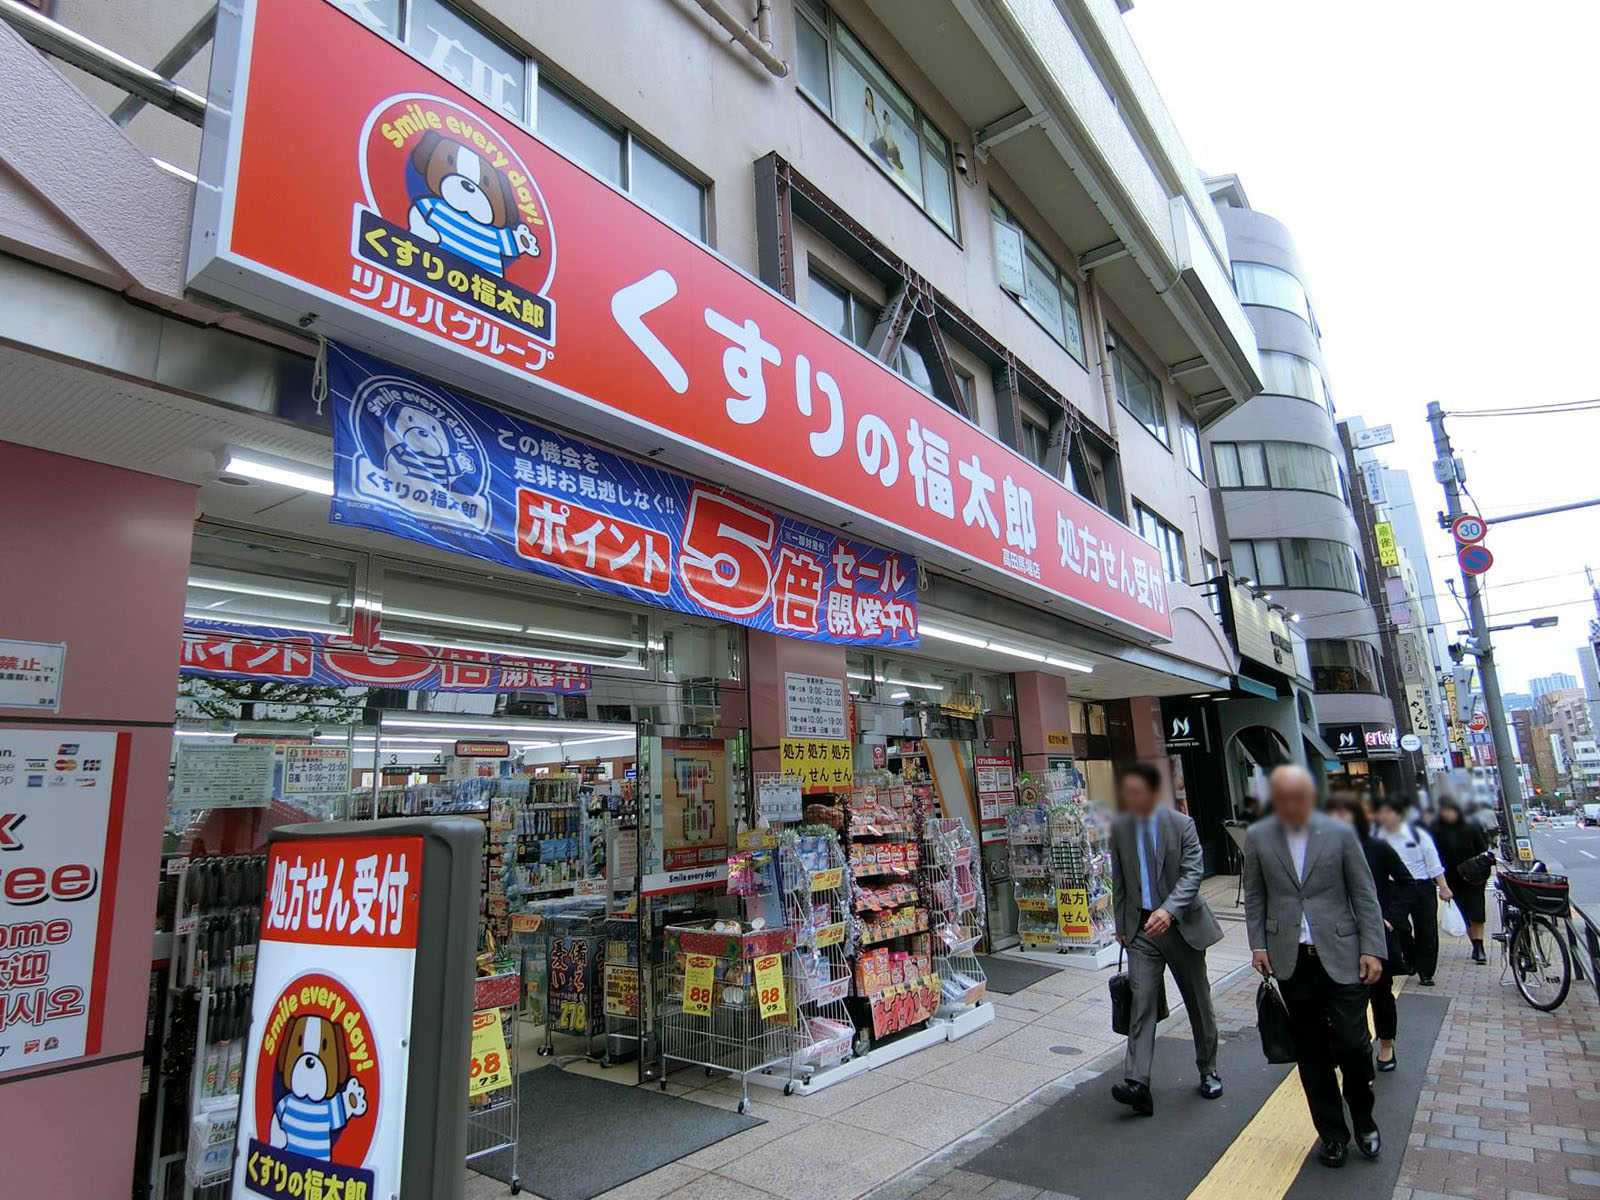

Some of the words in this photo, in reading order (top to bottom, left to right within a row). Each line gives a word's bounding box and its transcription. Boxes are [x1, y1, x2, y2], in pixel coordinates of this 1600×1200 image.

[380, 103, 442, 151] Smile
[445, 112, 510, 170] every
[508, 156, 545, 229] day!
[362, 226, 547, 330] くすりの福太郎
[349, 263, 555, 372] ツルハグループ
[402, 391, 446, 421] every
[444, 417, 475, 451] day!
[610, 267, 1037, 555] くすりの福太郎
[1056, 509, 1166, 616] 処方せん受付
[497, 427, 600, 475] この機会を
[365, 470, 479, 520] くすりの福太郎
[526, 501, 668, 584] ポイント
[679, 487, 777, 615] 5
[1460, 522, 1480, 538] 30
[771, 547, 823, 634] 倍
[832, 544, 906, 593] セール
[390, 754, 398, 765] 3
[433, 754, 441, 765] 4
[783, 742, 804, 760] 処方
[808, 742, 829, 760] 処方
[832, 744, 850, 760] 処方
[809, 768, 829, 782] せん
[832, 768, 853, 783] せん
[266, 853, 409, 937] 処方せん受付
[1060, 892, 1084, 906] 処方
[1062, 911, 1087, 923] せん
[559, 1001, 587, 1031] 278
[689, 986, 711, 1004] 88
[760, 987, 780, 1005] 88
[300, 985, 347, 1020] every
[342, 1010, 375, 1073] day!
[247, 1151, 368, 1200] くすりの福太郎
